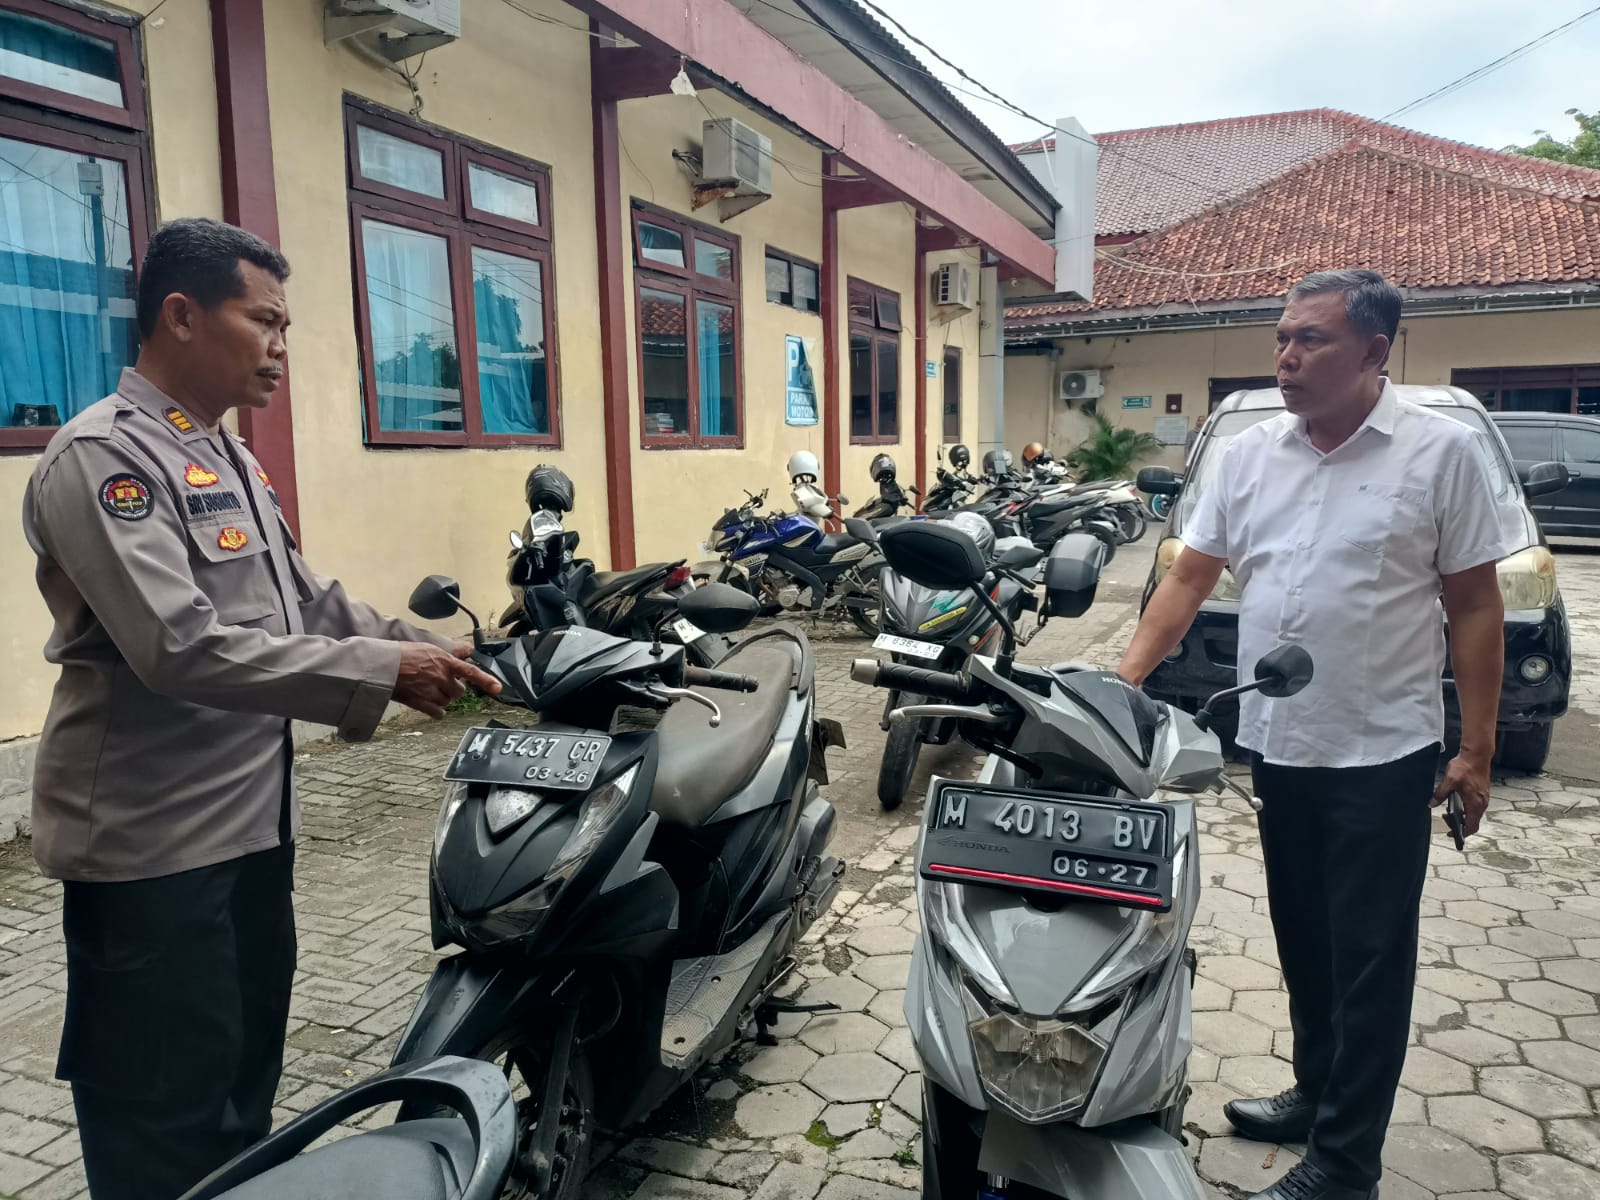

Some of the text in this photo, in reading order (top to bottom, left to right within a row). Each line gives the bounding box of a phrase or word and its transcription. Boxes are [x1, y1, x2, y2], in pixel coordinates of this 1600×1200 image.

[788, 341, 800, 382] P
[791, 405, 814, 418] MOTOR
[500, 733, 560, 758] 5437
[568, 740, 602, 762] CR
[943, 794, 1158, 851] M 4013 BV
[952, 839, 1011, 854] HONDA
